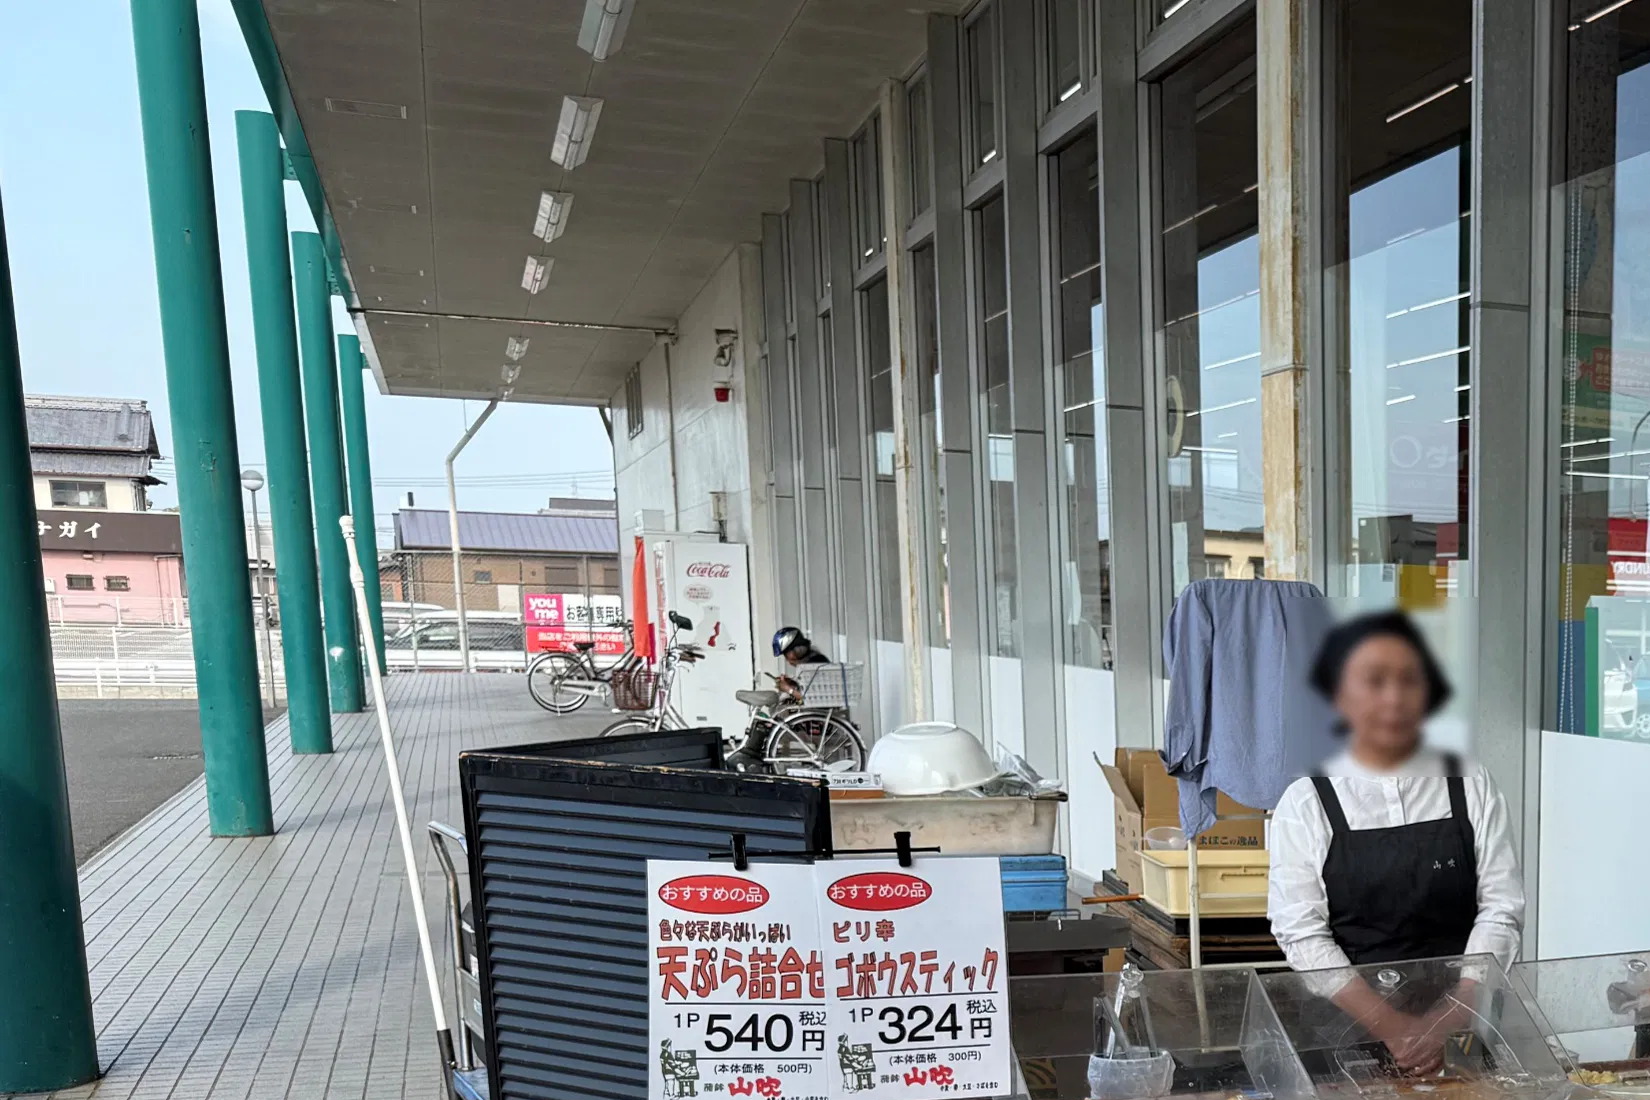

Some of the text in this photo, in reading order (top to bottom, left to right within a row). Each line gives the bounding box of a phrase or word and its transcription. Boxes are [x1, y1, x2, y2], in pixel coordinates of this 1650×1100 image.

[529, 598, 557, 610] you
[534, 609, 559, 620] me
[661, 884, 763, 904] おすすめの品
[830, 882, 927, 900] おすすめの品
[659, 918, 791, 944] 色々な天ぷらがいっぱい
[833, 919, 895, 943] ピリ辛
[656, 945, 826, 1001] 天ぷら詰合せ
[835, 947, 999, 999] ゴボウスティック
[966, 999, 998, 1015] 税込
[798, 1011, 828, 1027] 税込
[848, 1007, 874, 1023] 1P
[878, 1002, 963, 1045] 324
[674, 1012, 701, 1029] 1P
[704, 1012, 794, 1053] 540
[727, 1075, 783, 1099] 山吹
[903, 1064, 955, 1087] 山吹
